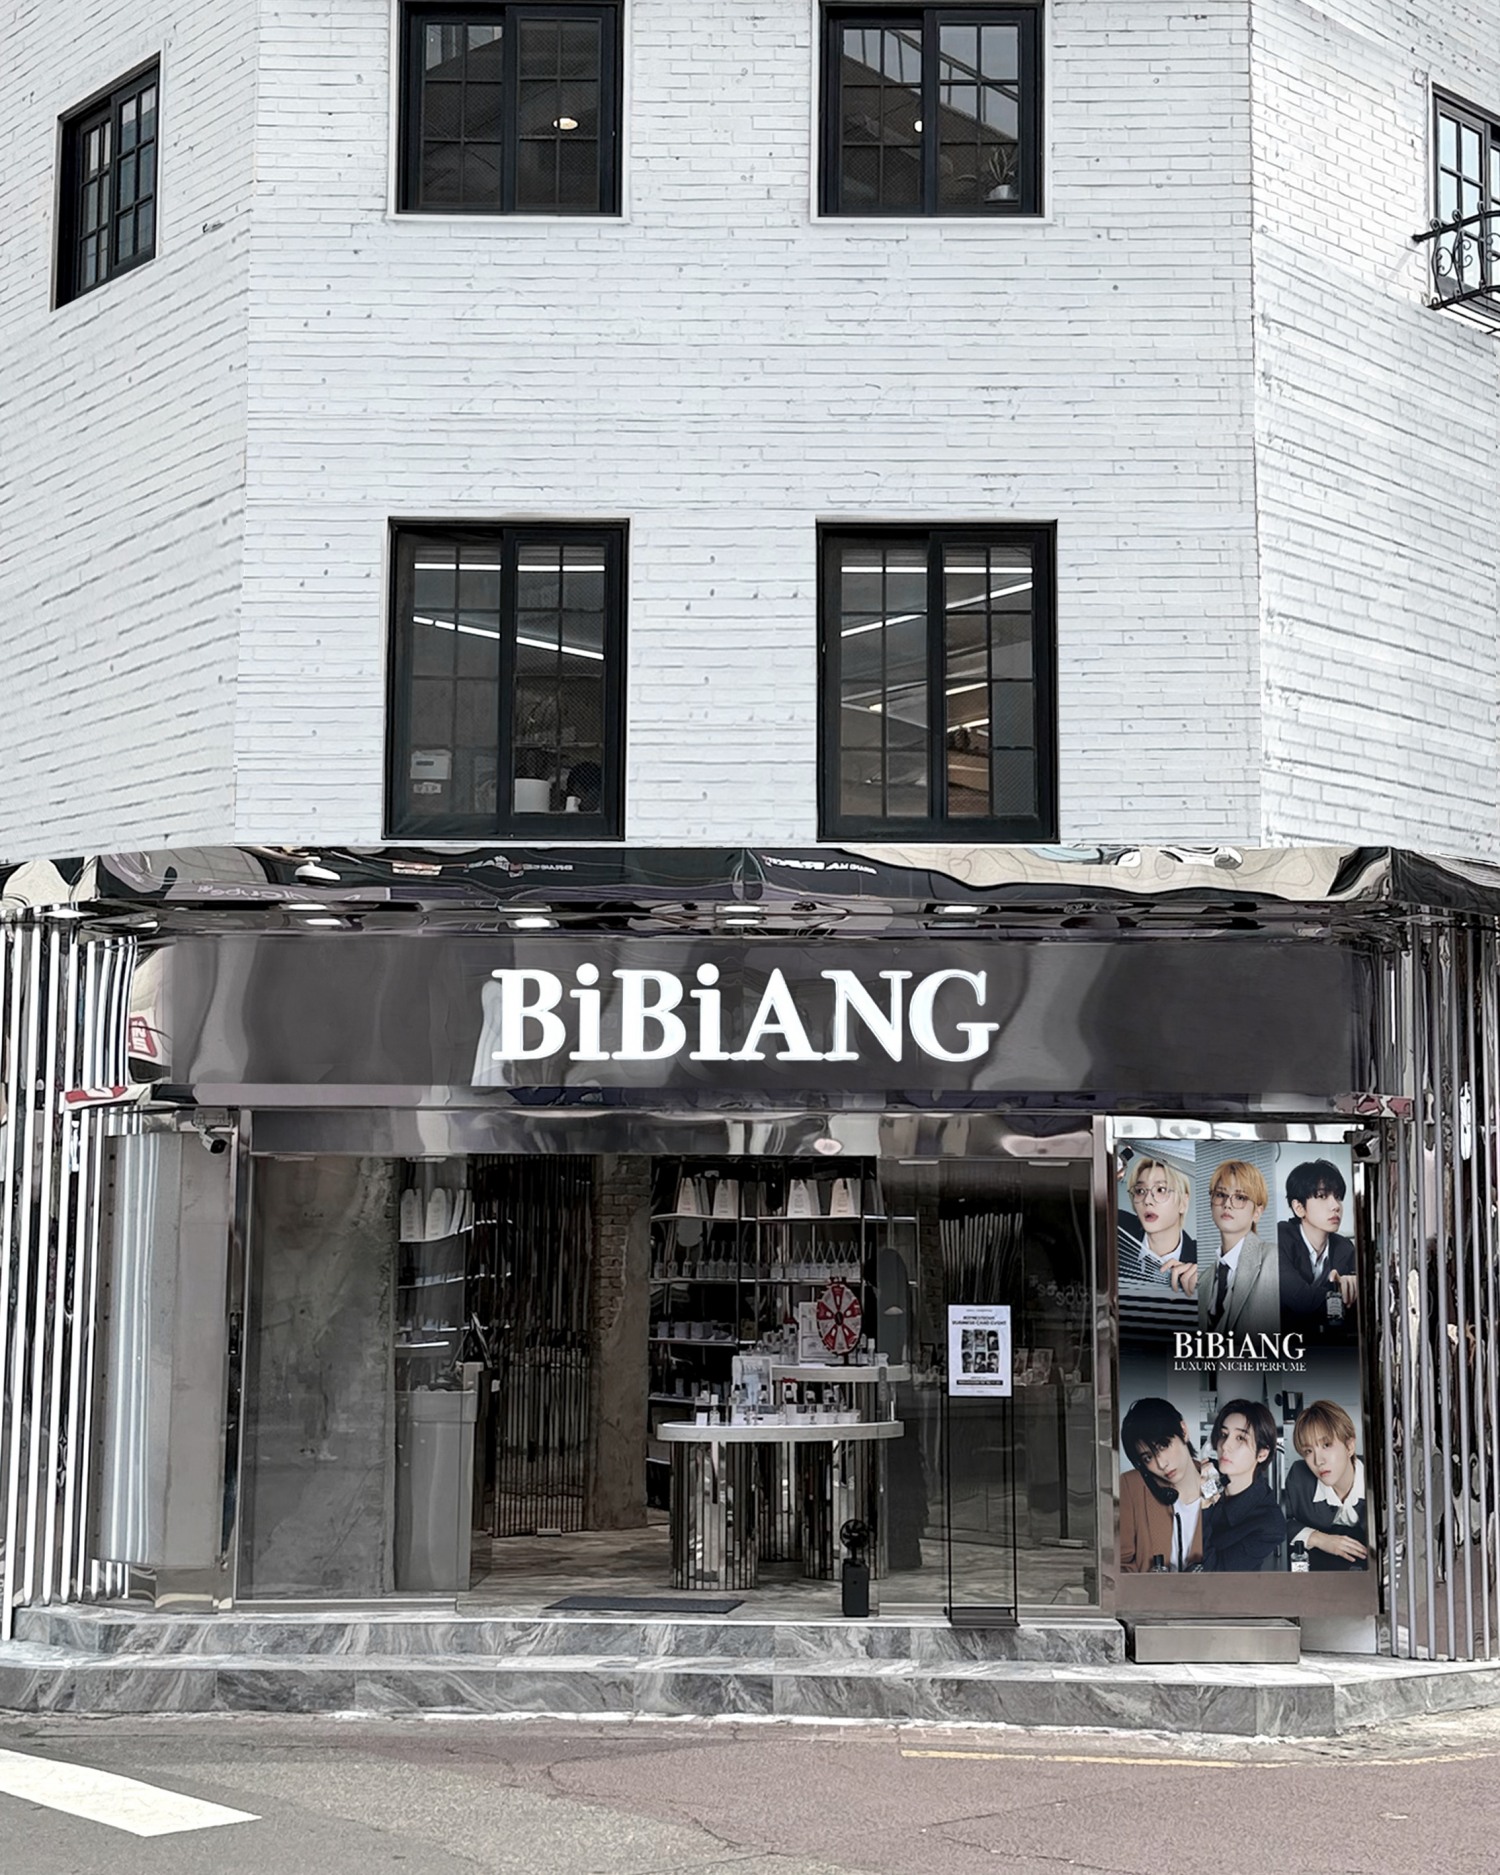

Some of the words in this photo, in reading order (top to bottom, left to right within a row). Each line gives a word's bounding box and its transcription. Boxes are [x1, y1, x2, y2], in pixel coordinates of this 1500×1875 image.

[491, 963, 1000, 1062] BiBiANG
[1173, 1331, 1306, 1360] BiBiANG
[1174, 1361, 1217, 1371] LUXURY
[1219, 1361, 1254, 1371] NICHE
[1256, 1361, 1307, 1372] PERFUME
